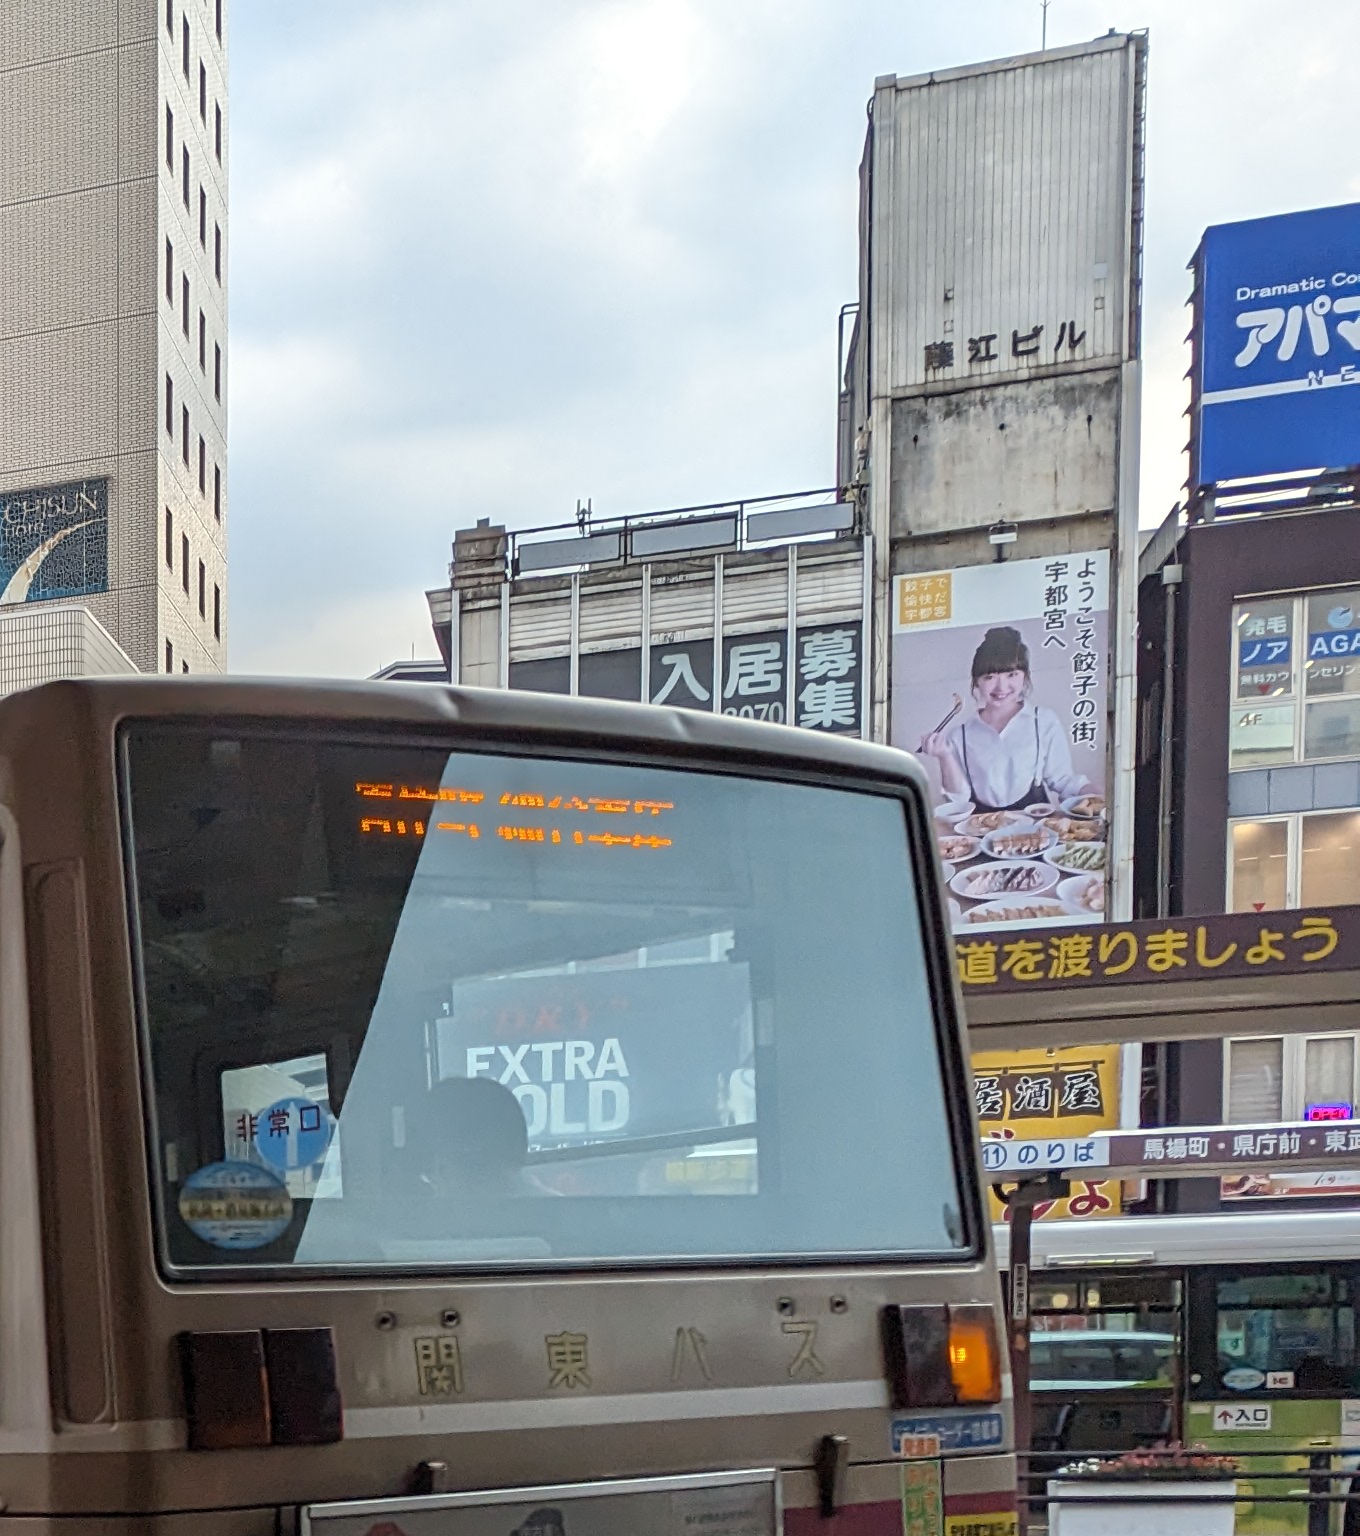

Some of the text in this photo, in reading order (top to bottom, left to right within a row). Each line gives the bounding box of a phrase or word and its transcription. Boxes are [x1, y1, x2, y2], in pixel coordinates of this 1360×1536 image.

[1236, 272, 1360, 301] Dramatic Co
[4, 481, 98, 524] CHISUN
[1042, 561, 1069, 650] 宇都宮へ
[1245, 615, 1288, 637] 発毛
[1070, 557, 1098, 752] ようこそ餃子の街、
[1242, 640, 1289, 663] ノア
[798, 629, 858, 729] 募集
[466, 1037, 630, 1085] EXTRA
[236, 1105, 321, 1142] 非常口
[510, 1079, 630, 1138] OLD
[1309, 1106, 1350, 1121] OPEN
[1018, 1141, 1095, 1165] のりば
[1235, 1408, 1269, 1422] 入口
